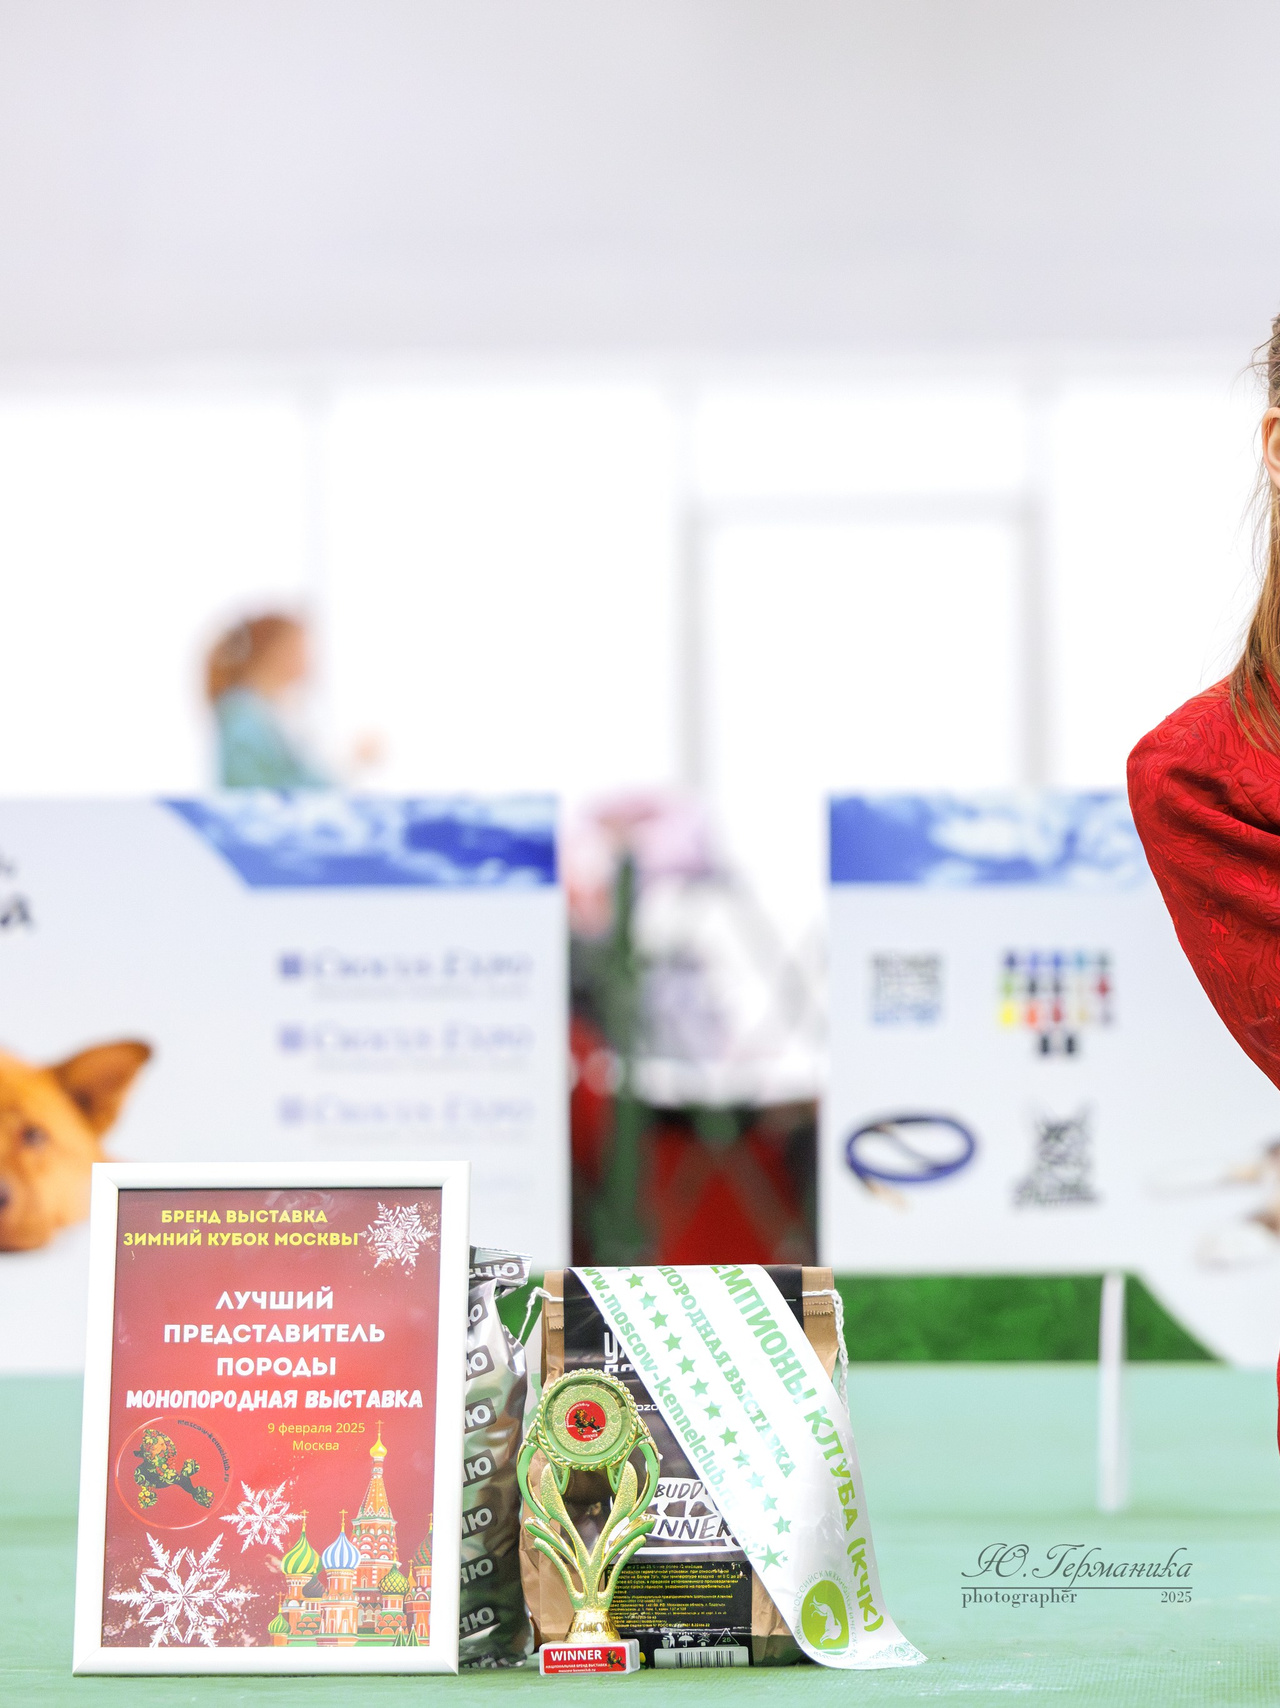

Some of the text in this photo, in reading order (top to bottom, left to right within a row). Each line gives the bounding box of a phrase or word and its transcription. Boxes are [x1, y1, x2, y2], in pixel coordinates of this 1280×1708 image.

[161, 1209, 329, 1224] БРЕНД ВЫСТАВКА
[123, 1229, 359, 1246] ЗИМНИЙ КУБОК МОСКВЫ
[215, 1286, 334, 1310] ЛУЧШИЙ
[163, 1323, 386, 1345] ПРЕДСТАВИТЕЛЬ
[216, 1356, 337, 1378] ПОРОДЫ
[126, 1389, 424, 1412] МОНОПОРОДНАЯ ВЫСТАВКА
[267, 1421, 366, 1436] 9 февраля 2025
[722, 1365, 796, 1478] ВЫСТАВКА
[292, 1440, 340, 1452] Москва
[803, 1406, 858, 1532] КЛУБА
[550, 1650, 602, 1661] WINNER
